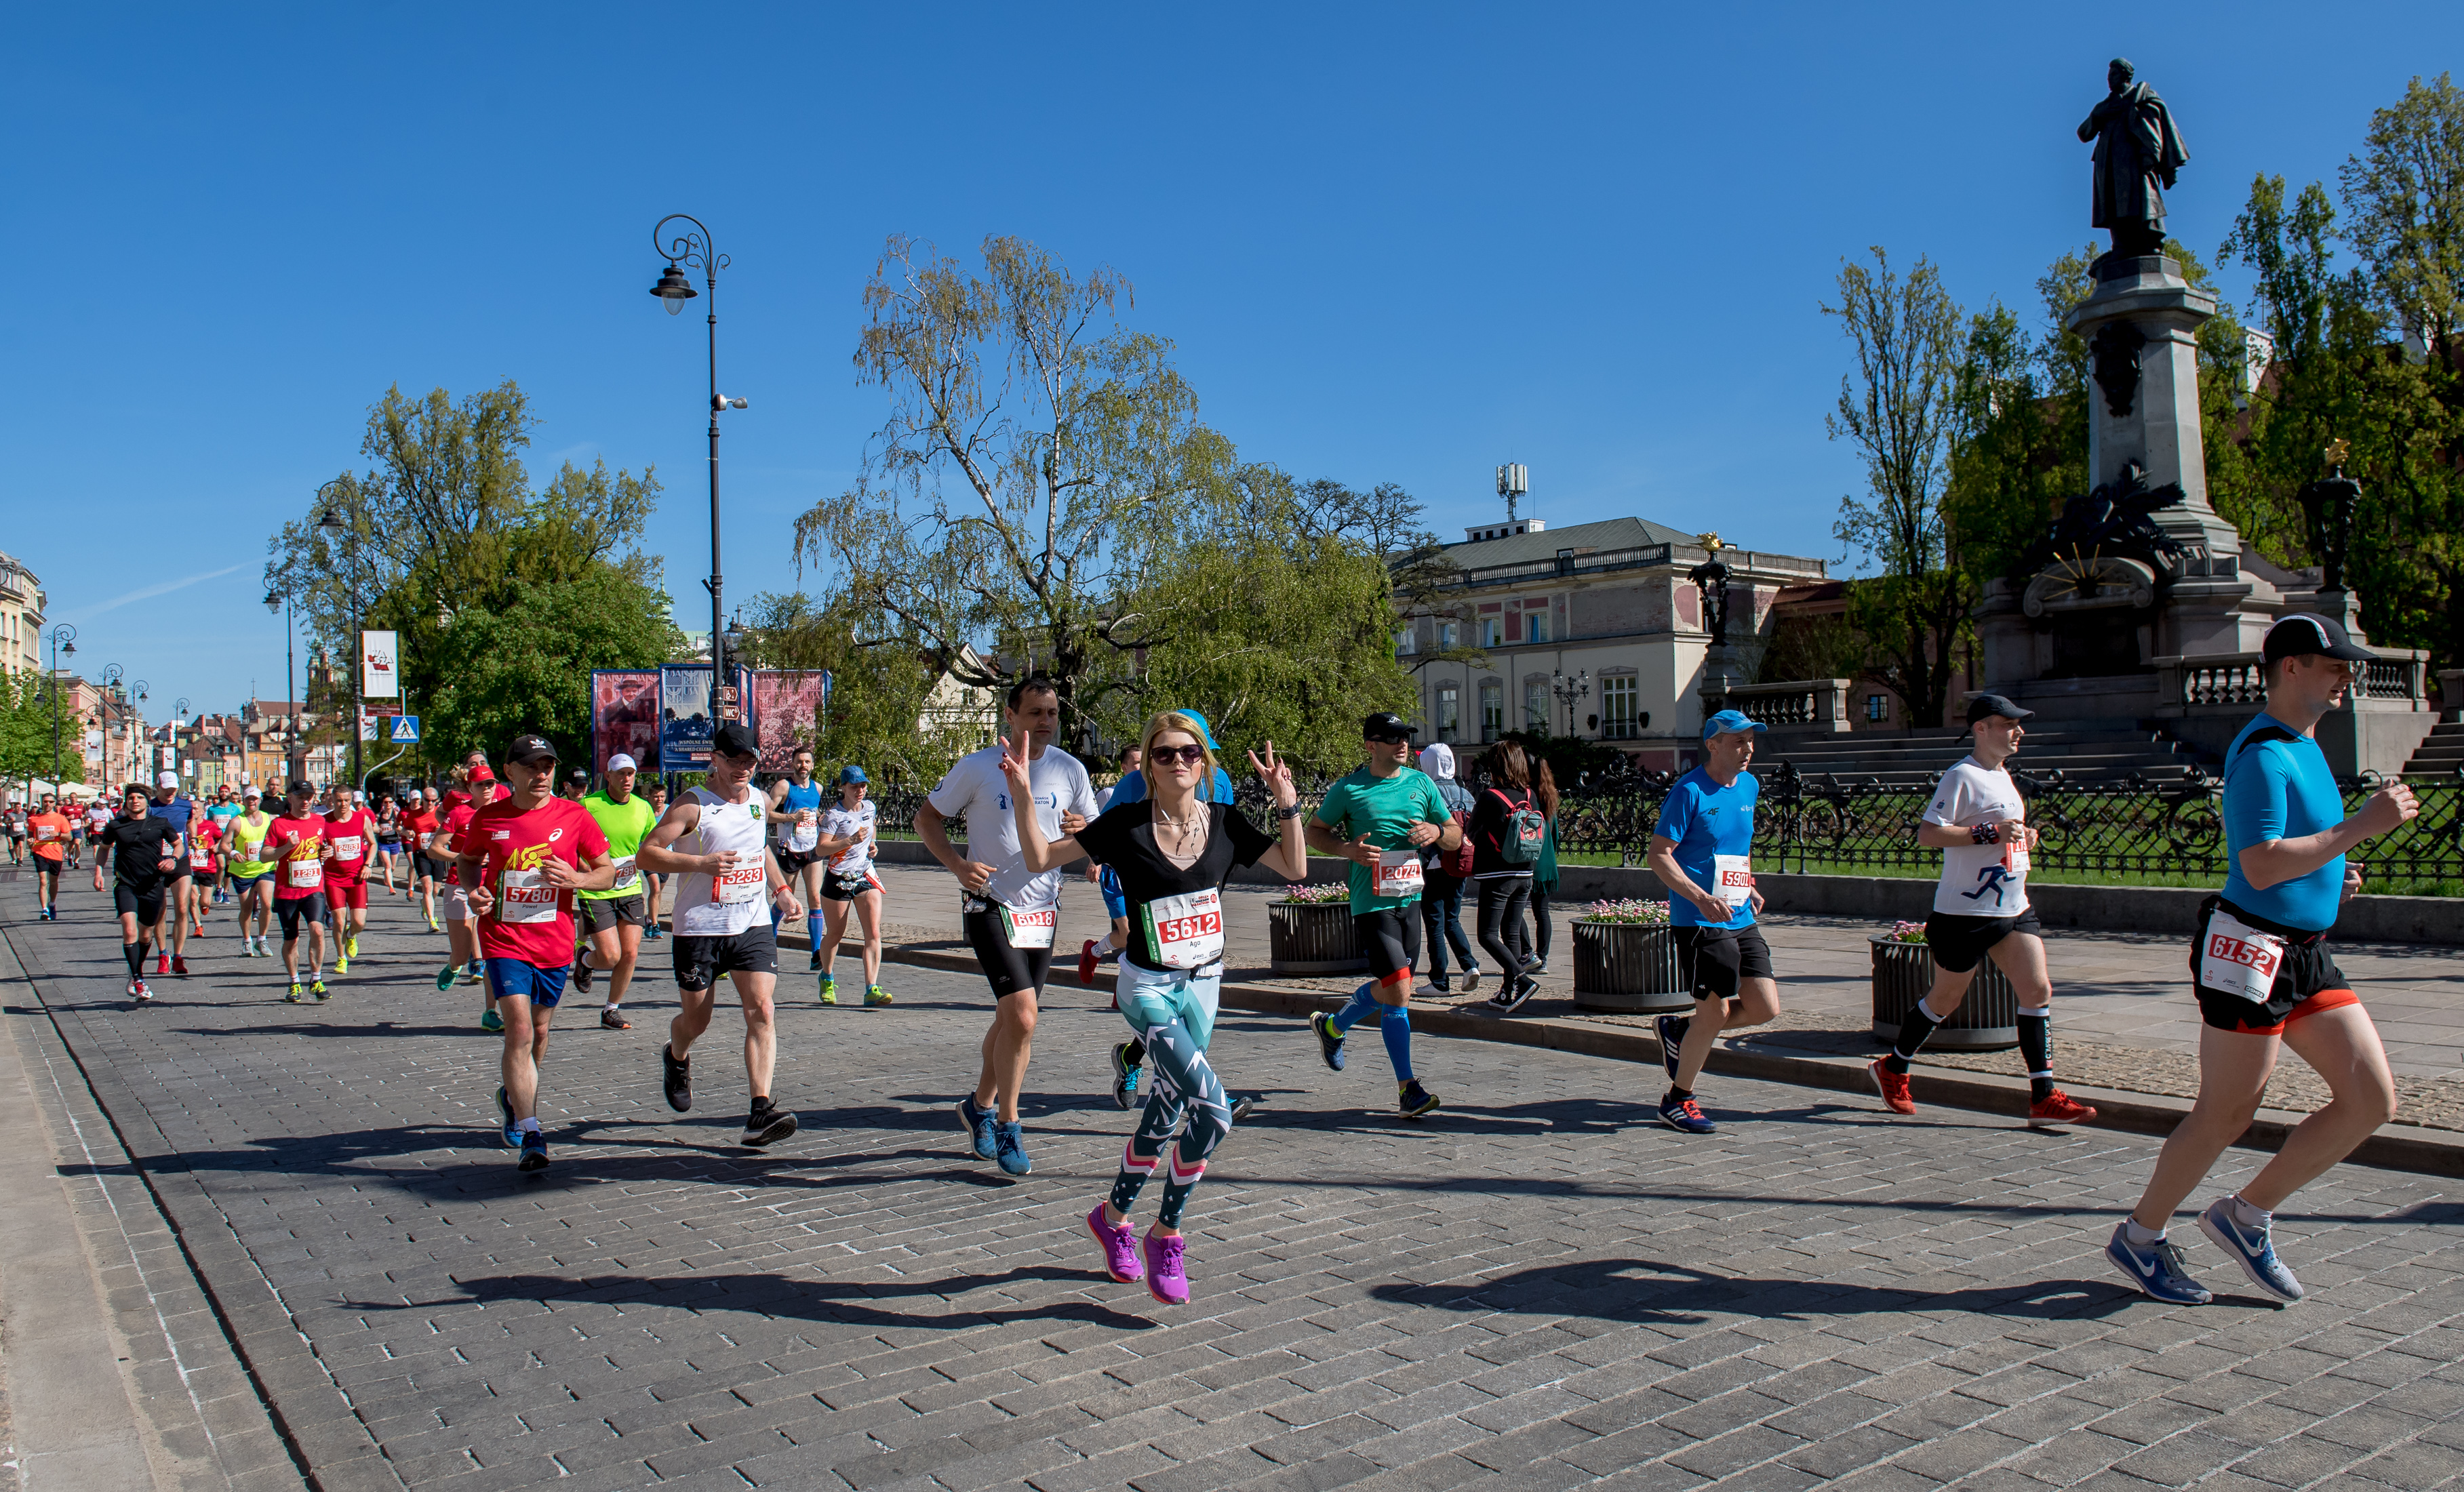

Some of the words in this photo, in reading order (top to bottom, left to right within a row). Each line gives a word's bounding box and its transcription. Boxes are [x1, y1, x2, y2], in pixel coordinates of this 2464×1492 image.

[683, 687, 699, 695] USA
[726, 708, 735, 717] WC
[1707, 807, 1720, 816] 4F
[338, 844, 358, 852] 2483
[296, 868, 318, 877] 1291
[726, 868, 761, 884] 5233
[1385, 865, 1418, 879] 2074
[1726, 872, 1749, 887] 5901
[510, 887, 553, 902] 5780
[1016, 911, 1053, 926] 6018
[1166, 913, 1217, 941] 5612
[2212, 936, 2271, 972] 6152
